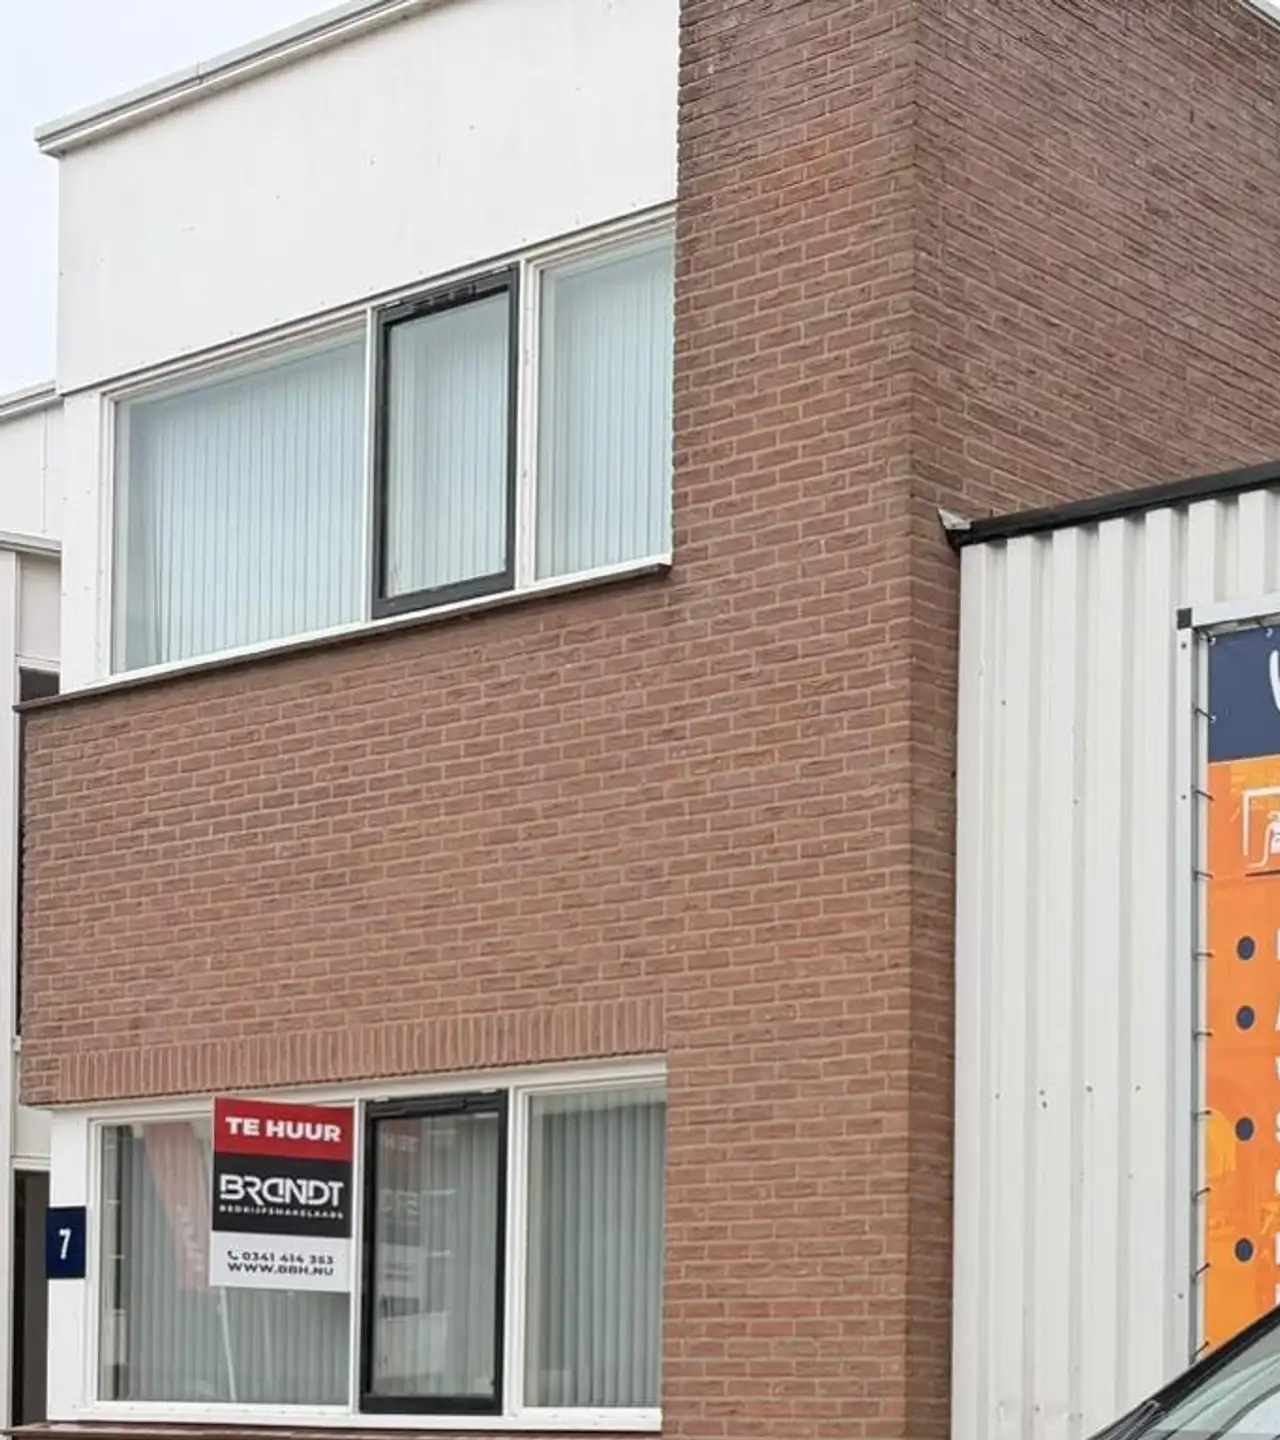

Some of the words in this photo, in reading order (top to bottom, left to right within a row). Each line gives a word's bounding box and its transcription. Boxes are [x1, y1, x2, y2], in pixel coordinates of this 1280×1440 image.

[225, 1116, 260, 1137] TE
[266, 1119, 342, 1143] HUUR
[219, 1173, 345, 1207] BRANDT
[58, 1227, 72, 1260] 7
